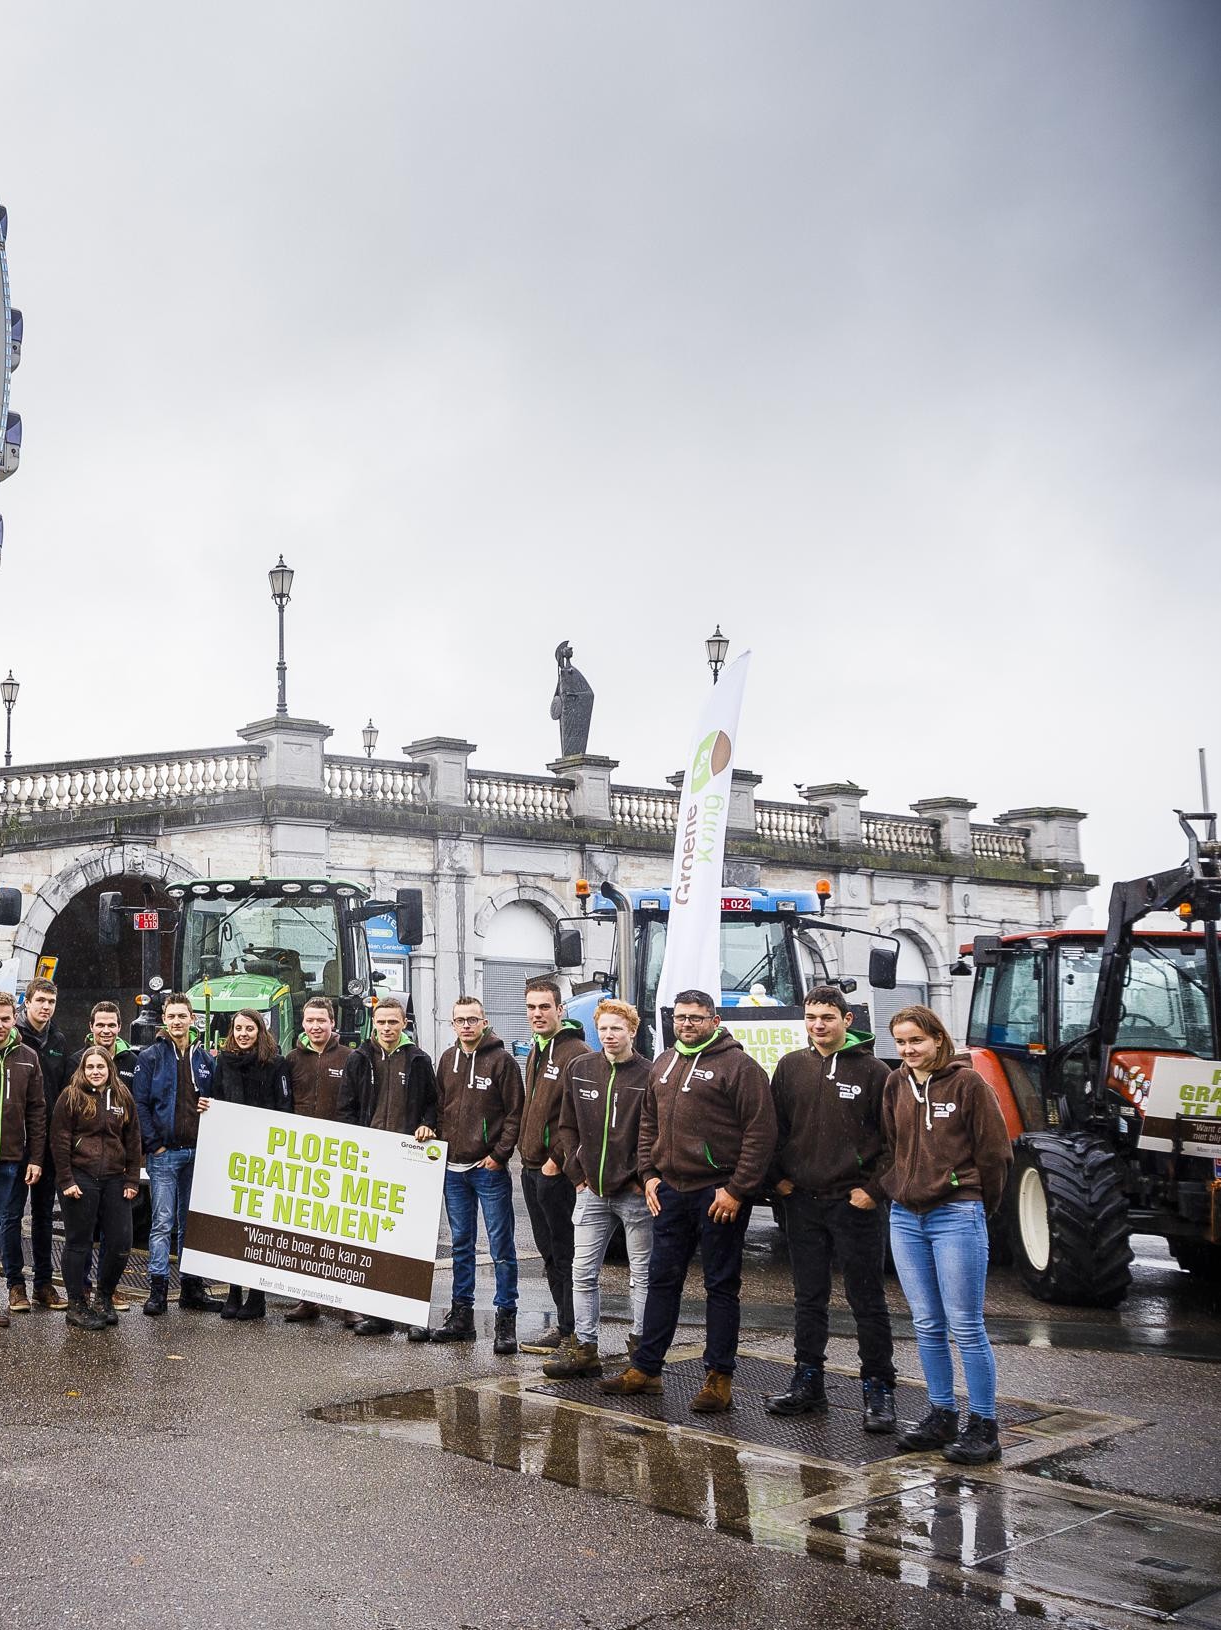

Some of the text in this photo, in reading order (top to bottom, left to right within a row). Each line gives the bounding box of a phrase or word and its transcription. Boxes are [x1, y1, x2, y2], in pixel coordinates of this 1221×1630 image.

[696, 794, 724, 864] Kring
[675, 803, 698, 905] Groene
[143, 921, 158, 929] 010
[733, 1027, 800, 1046] PLOEG:
[266, 1126, 371, 1173] PLOEG:
[400, 1141, 425, 1151] Groene
[228, 1151, 407, 1214] GRATIS MEE
[230, 1184, 265, 1219] TE
[244, 1245, 366, 1284] niet blijven voortploegen
[276, 1233, 289, 1250] de
[291, 1236, 316, 1257] boer,
[319, 1242, 335, 1260] die
[338, 1246, 356, 1265] kan
[359, 1254, 373, 1268] zo
